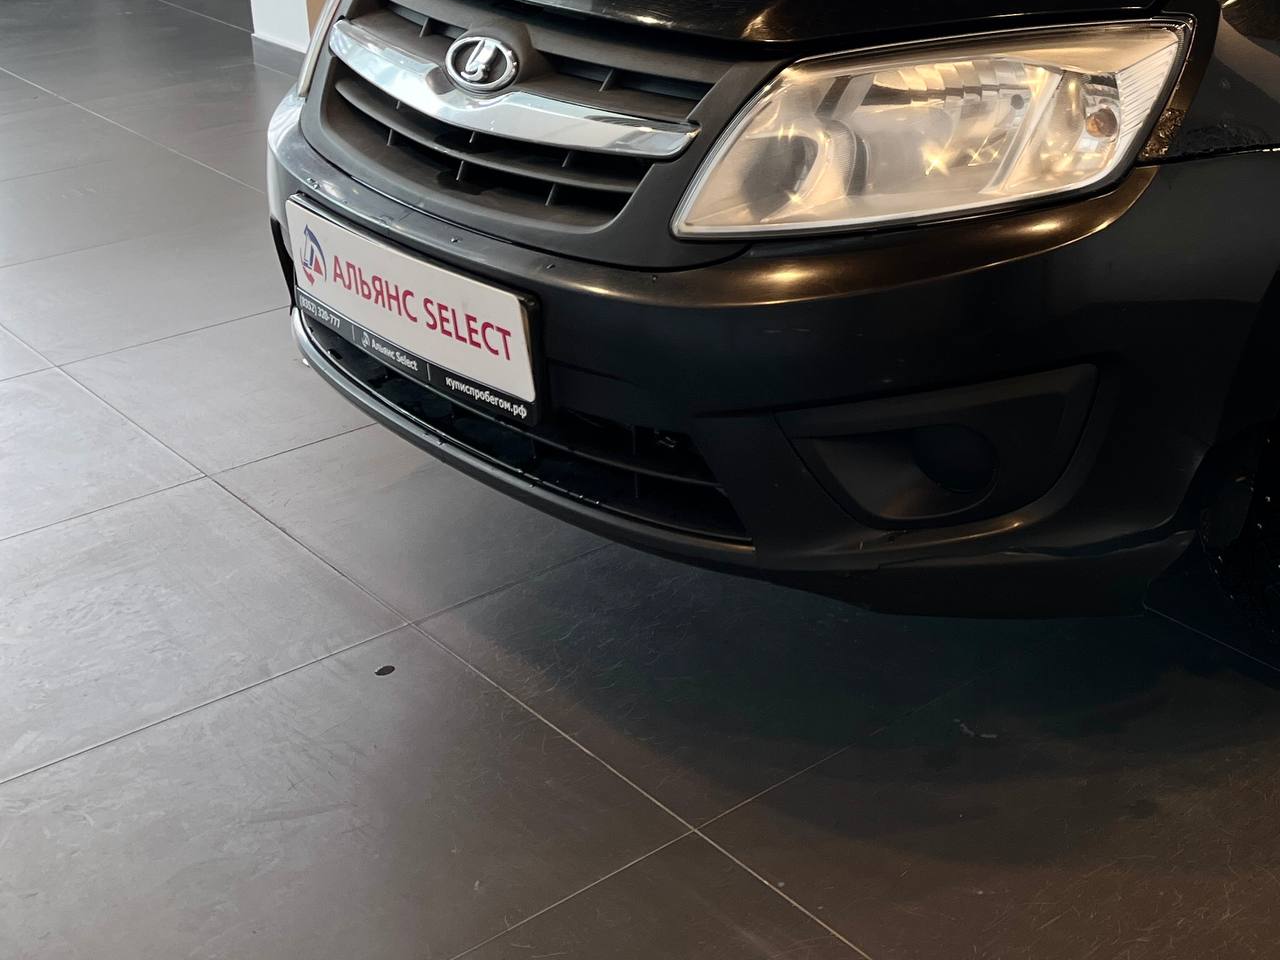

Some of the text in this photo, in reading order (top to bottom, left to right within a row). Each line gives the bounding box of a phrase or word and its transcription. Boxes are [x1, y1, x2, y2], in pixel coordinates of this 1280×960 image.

[332, 254, 512, 361] АЛЬЯНС SELECT
[395, 351, 419, 372] Select
[445, 376, 528, 420] куписпробегом.рф
